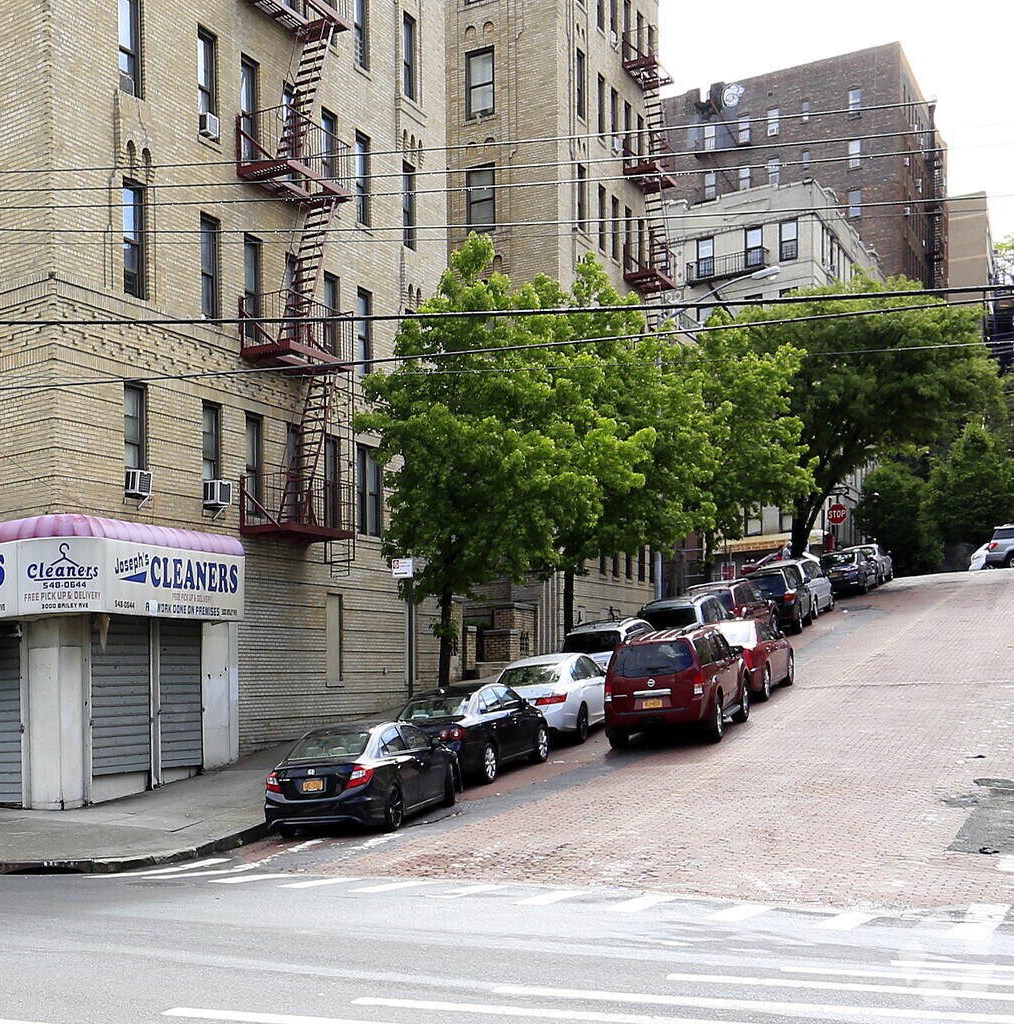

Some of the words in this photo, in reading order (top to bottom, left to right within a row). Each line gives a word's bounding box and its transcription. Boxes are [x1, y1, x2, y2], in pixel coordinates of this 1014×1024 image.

[828, 510, 846, 518] STOP
[27, 562, 98, 578] Cleaners
[114, 552, 150, 574] Joseph's
[150, 556, 238, 594] CLEANERS
[24, 592, 40, 602] FREE
[40, 592, 56, 600] PICK
[57, 592, 66, 600] UP
[68, 592, 72, 600] &
[74, 591, 100, 600] DELIVERY
[172, 604, 186, 614] DONE
[188, 605, 194, 615] ON
[196, 606, 220, 616] PREMISES
